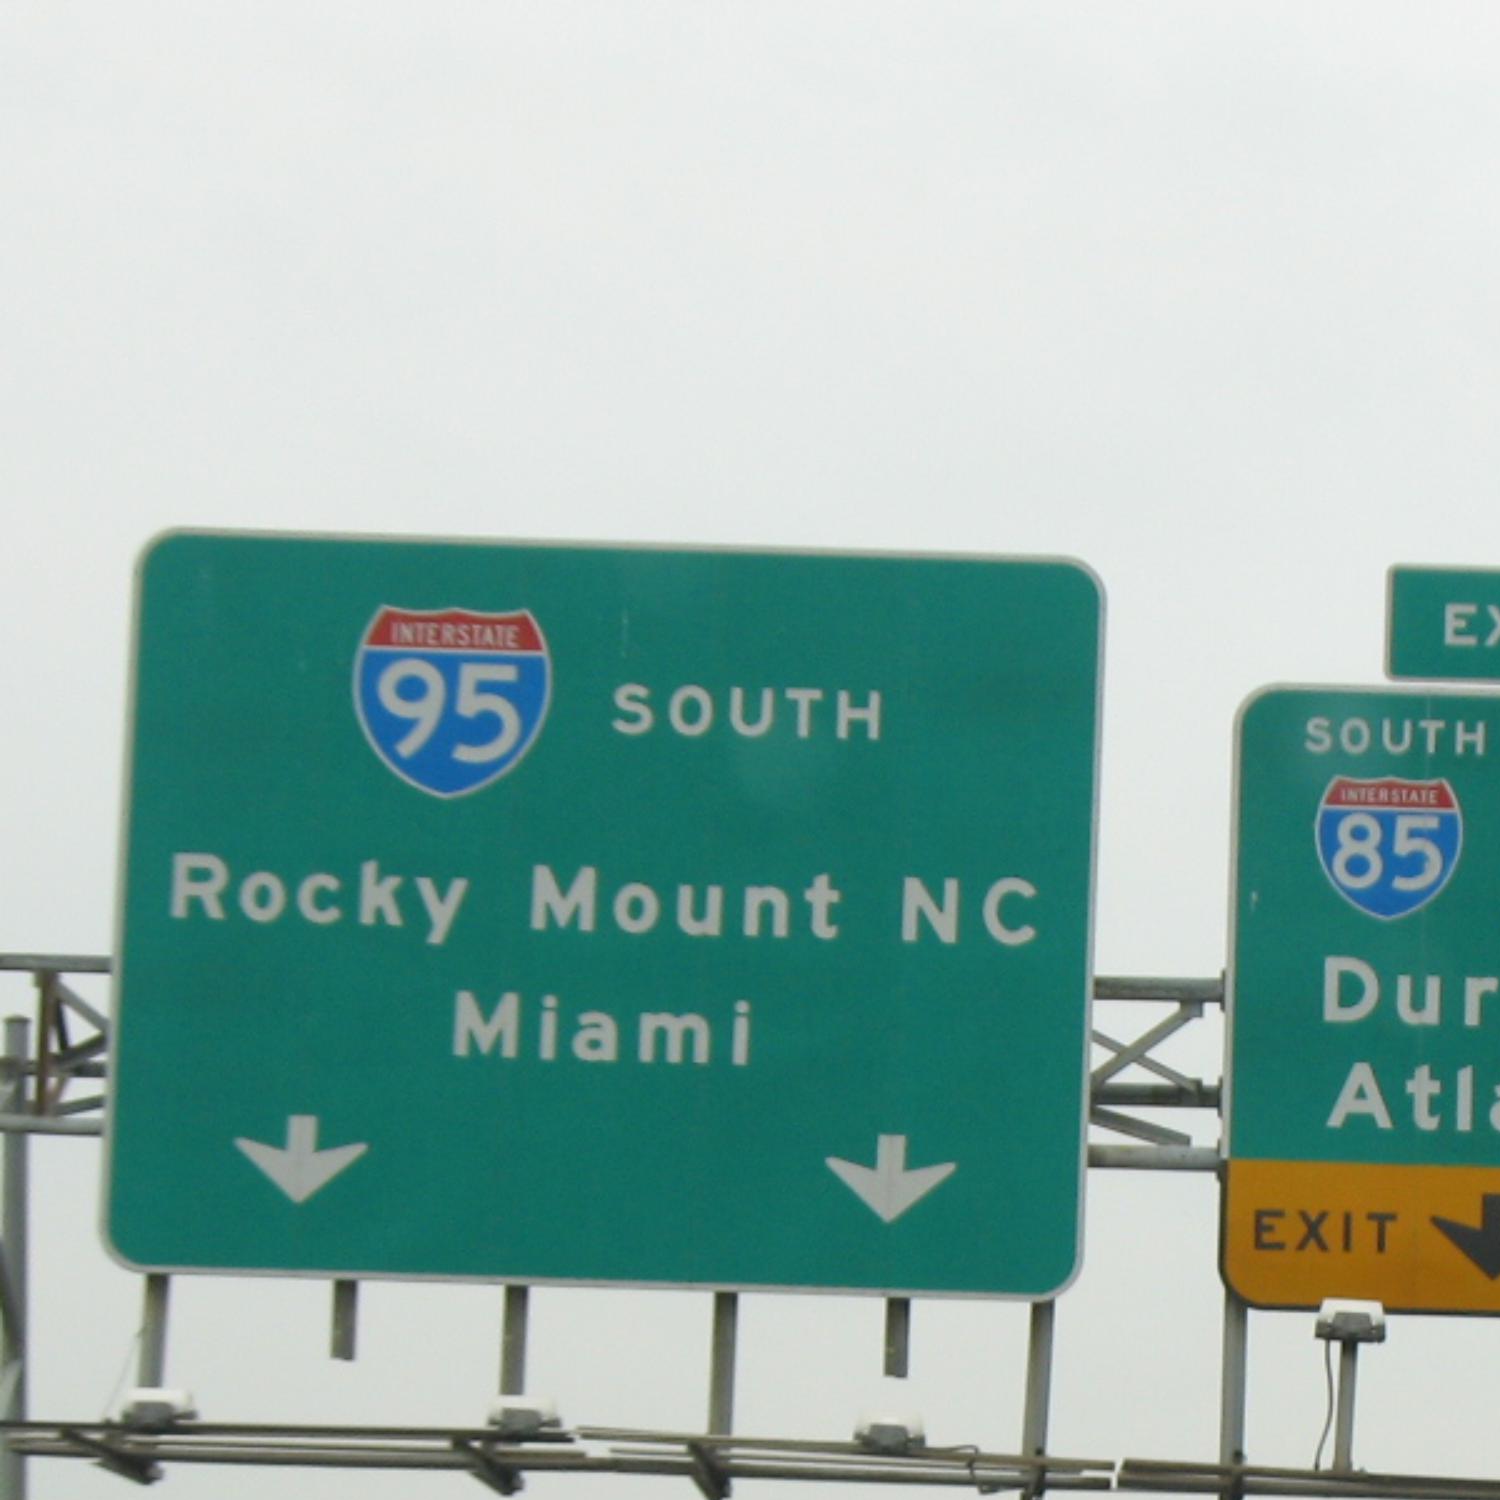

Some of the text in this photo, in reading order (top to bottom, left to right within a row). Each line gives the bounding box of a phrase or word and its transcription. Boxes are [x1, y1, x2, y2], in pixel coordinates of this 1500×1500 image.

[391, 622, 521, 648] INTERSTATE
[378, 658, 521, 764] 95
[613, 683, 882, 741] SOUTH
[1304, 716, 1487, 756] SOUTH
[1341, 787, 1439, 805] INTERSTATE
[1332, 812, 1443, 892] 85
[171, 852, 469, 945] Rocky
[530, 864, 841, 940] Mount
[453, 990, 752, 1067] Miami
[1253, 1209, 1399, 1254] EXIT
